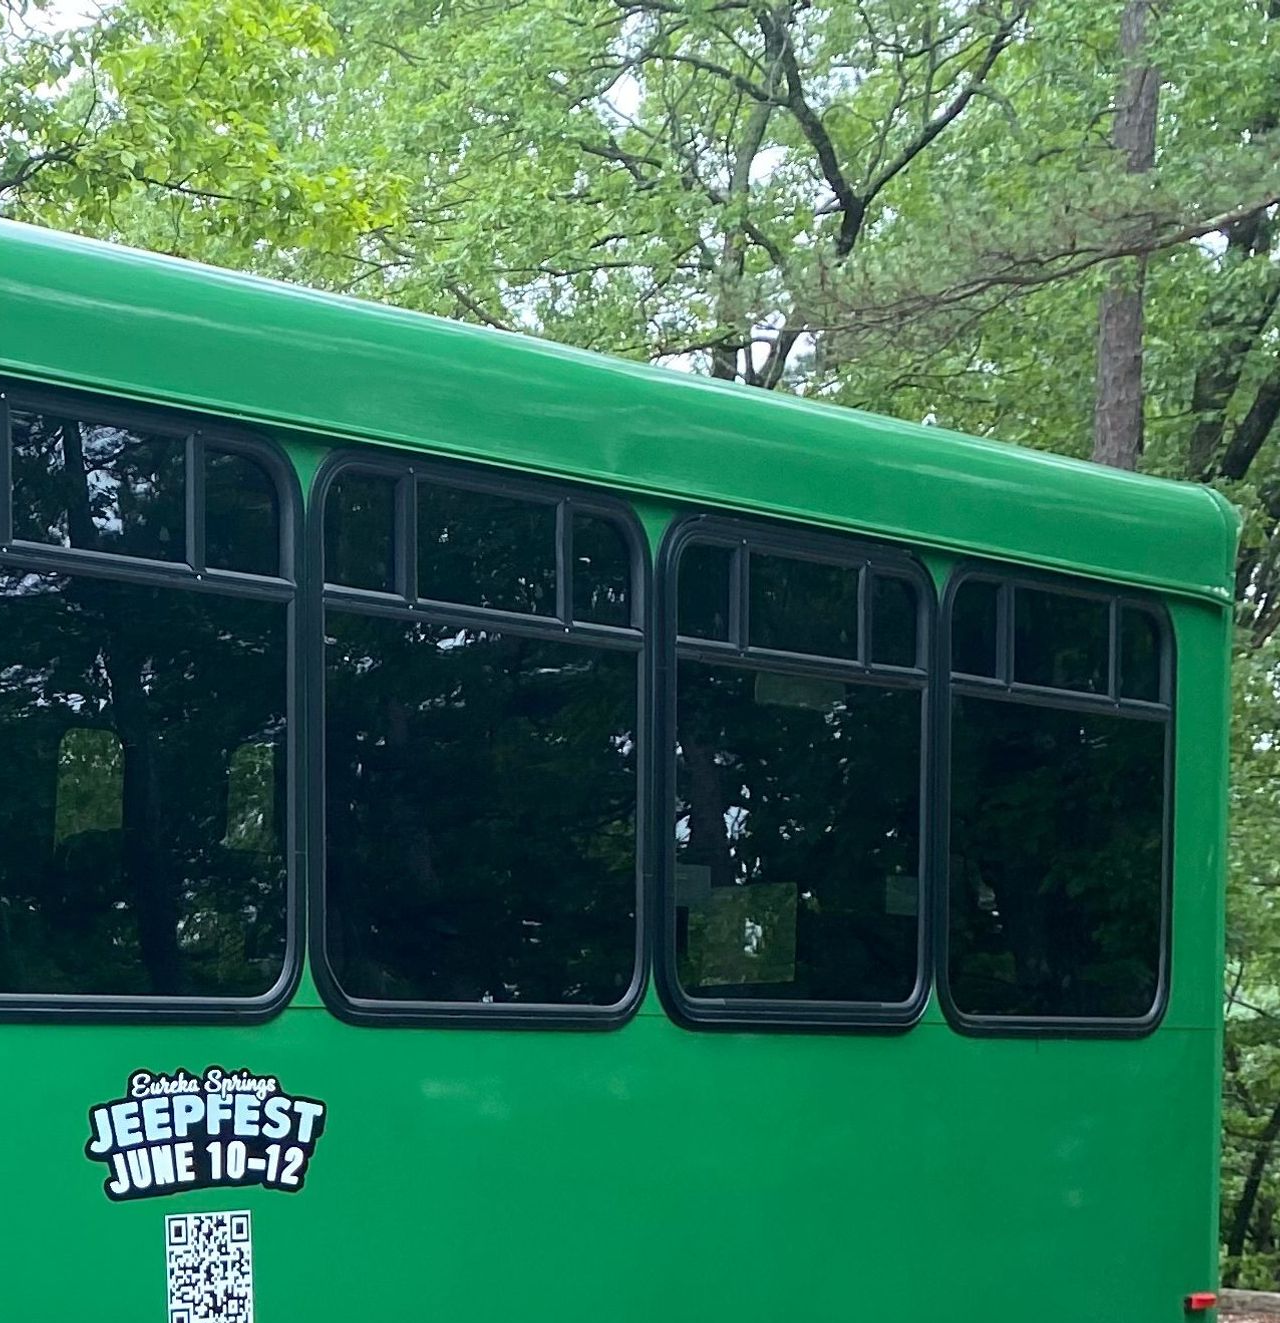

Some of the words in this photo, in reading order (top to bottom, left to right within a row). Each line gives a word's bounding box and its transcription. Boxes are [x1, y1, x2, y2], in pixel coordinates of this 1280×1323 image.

[131, 1073, 200, 1098] Eureka
[204, 1070, 276, 1100] Springs
[90, 1094, 323, 1154] JEEPFEST
[109, 1142, 195, 1194] JUNE
[206, 1141, 304, 1185] 10-12
